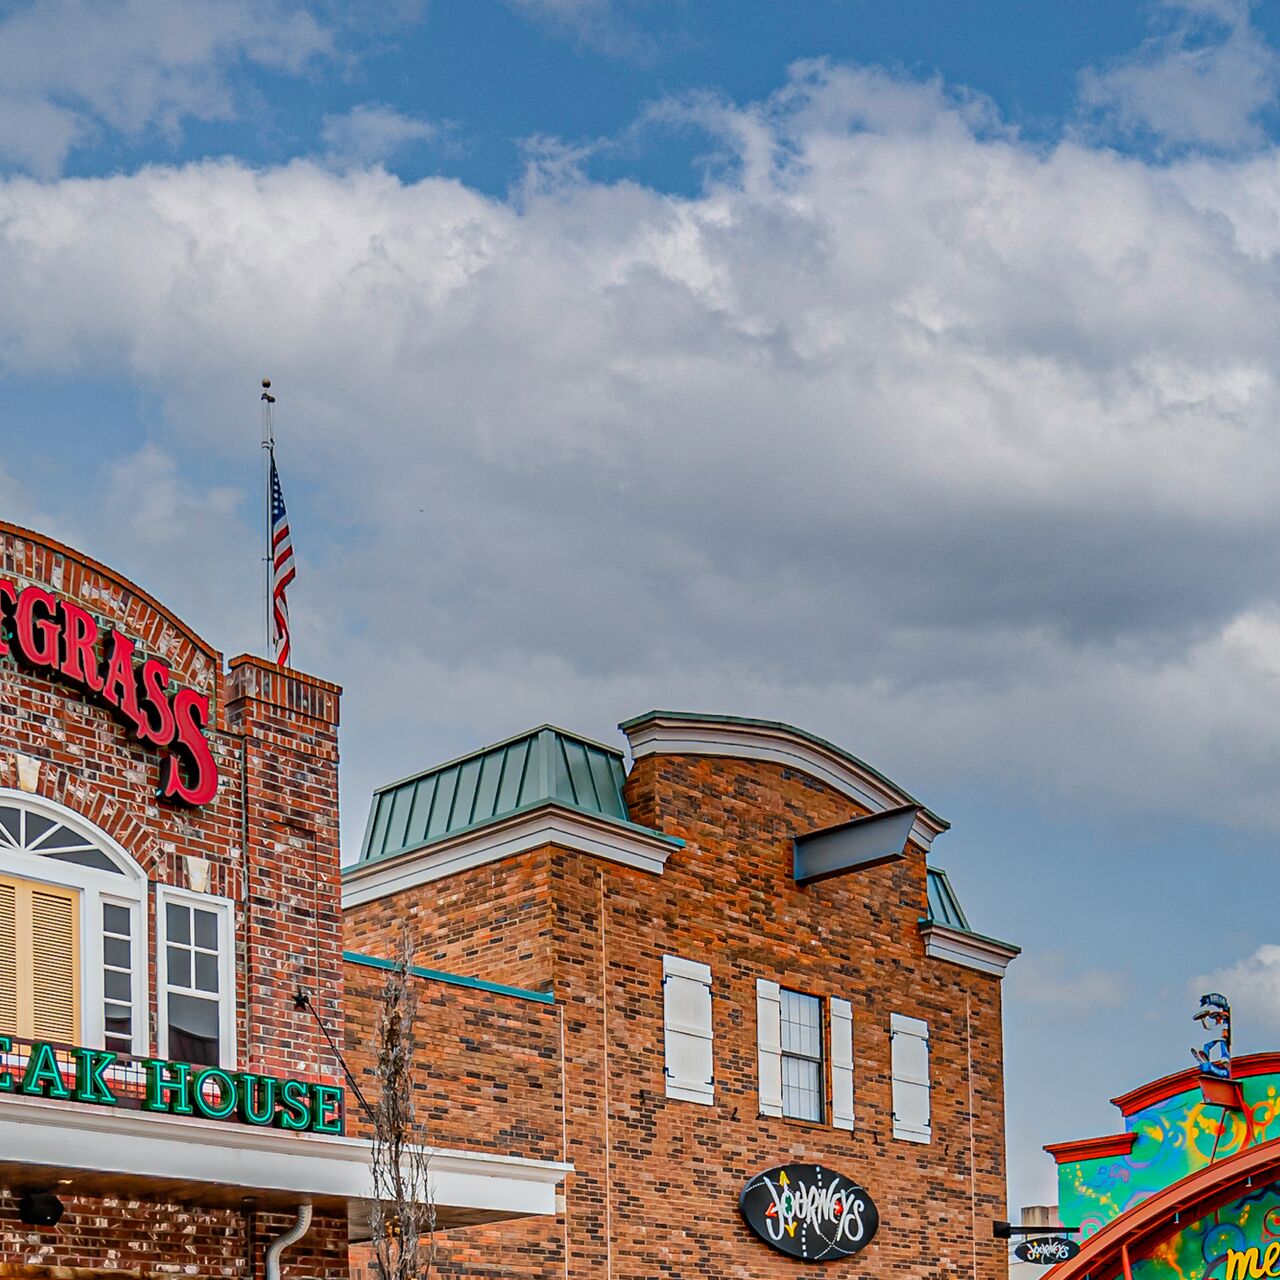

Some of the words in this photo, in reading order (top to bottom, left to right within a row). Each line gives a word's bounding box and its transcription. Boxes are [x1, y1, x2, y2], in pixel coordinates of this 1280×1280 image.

[143, 1058, 346, 1136] HOUSE
[763, 1175, 865, 1241] JOURNEYS
[1026, 1240, 1070, 1261] JOURNEYS
